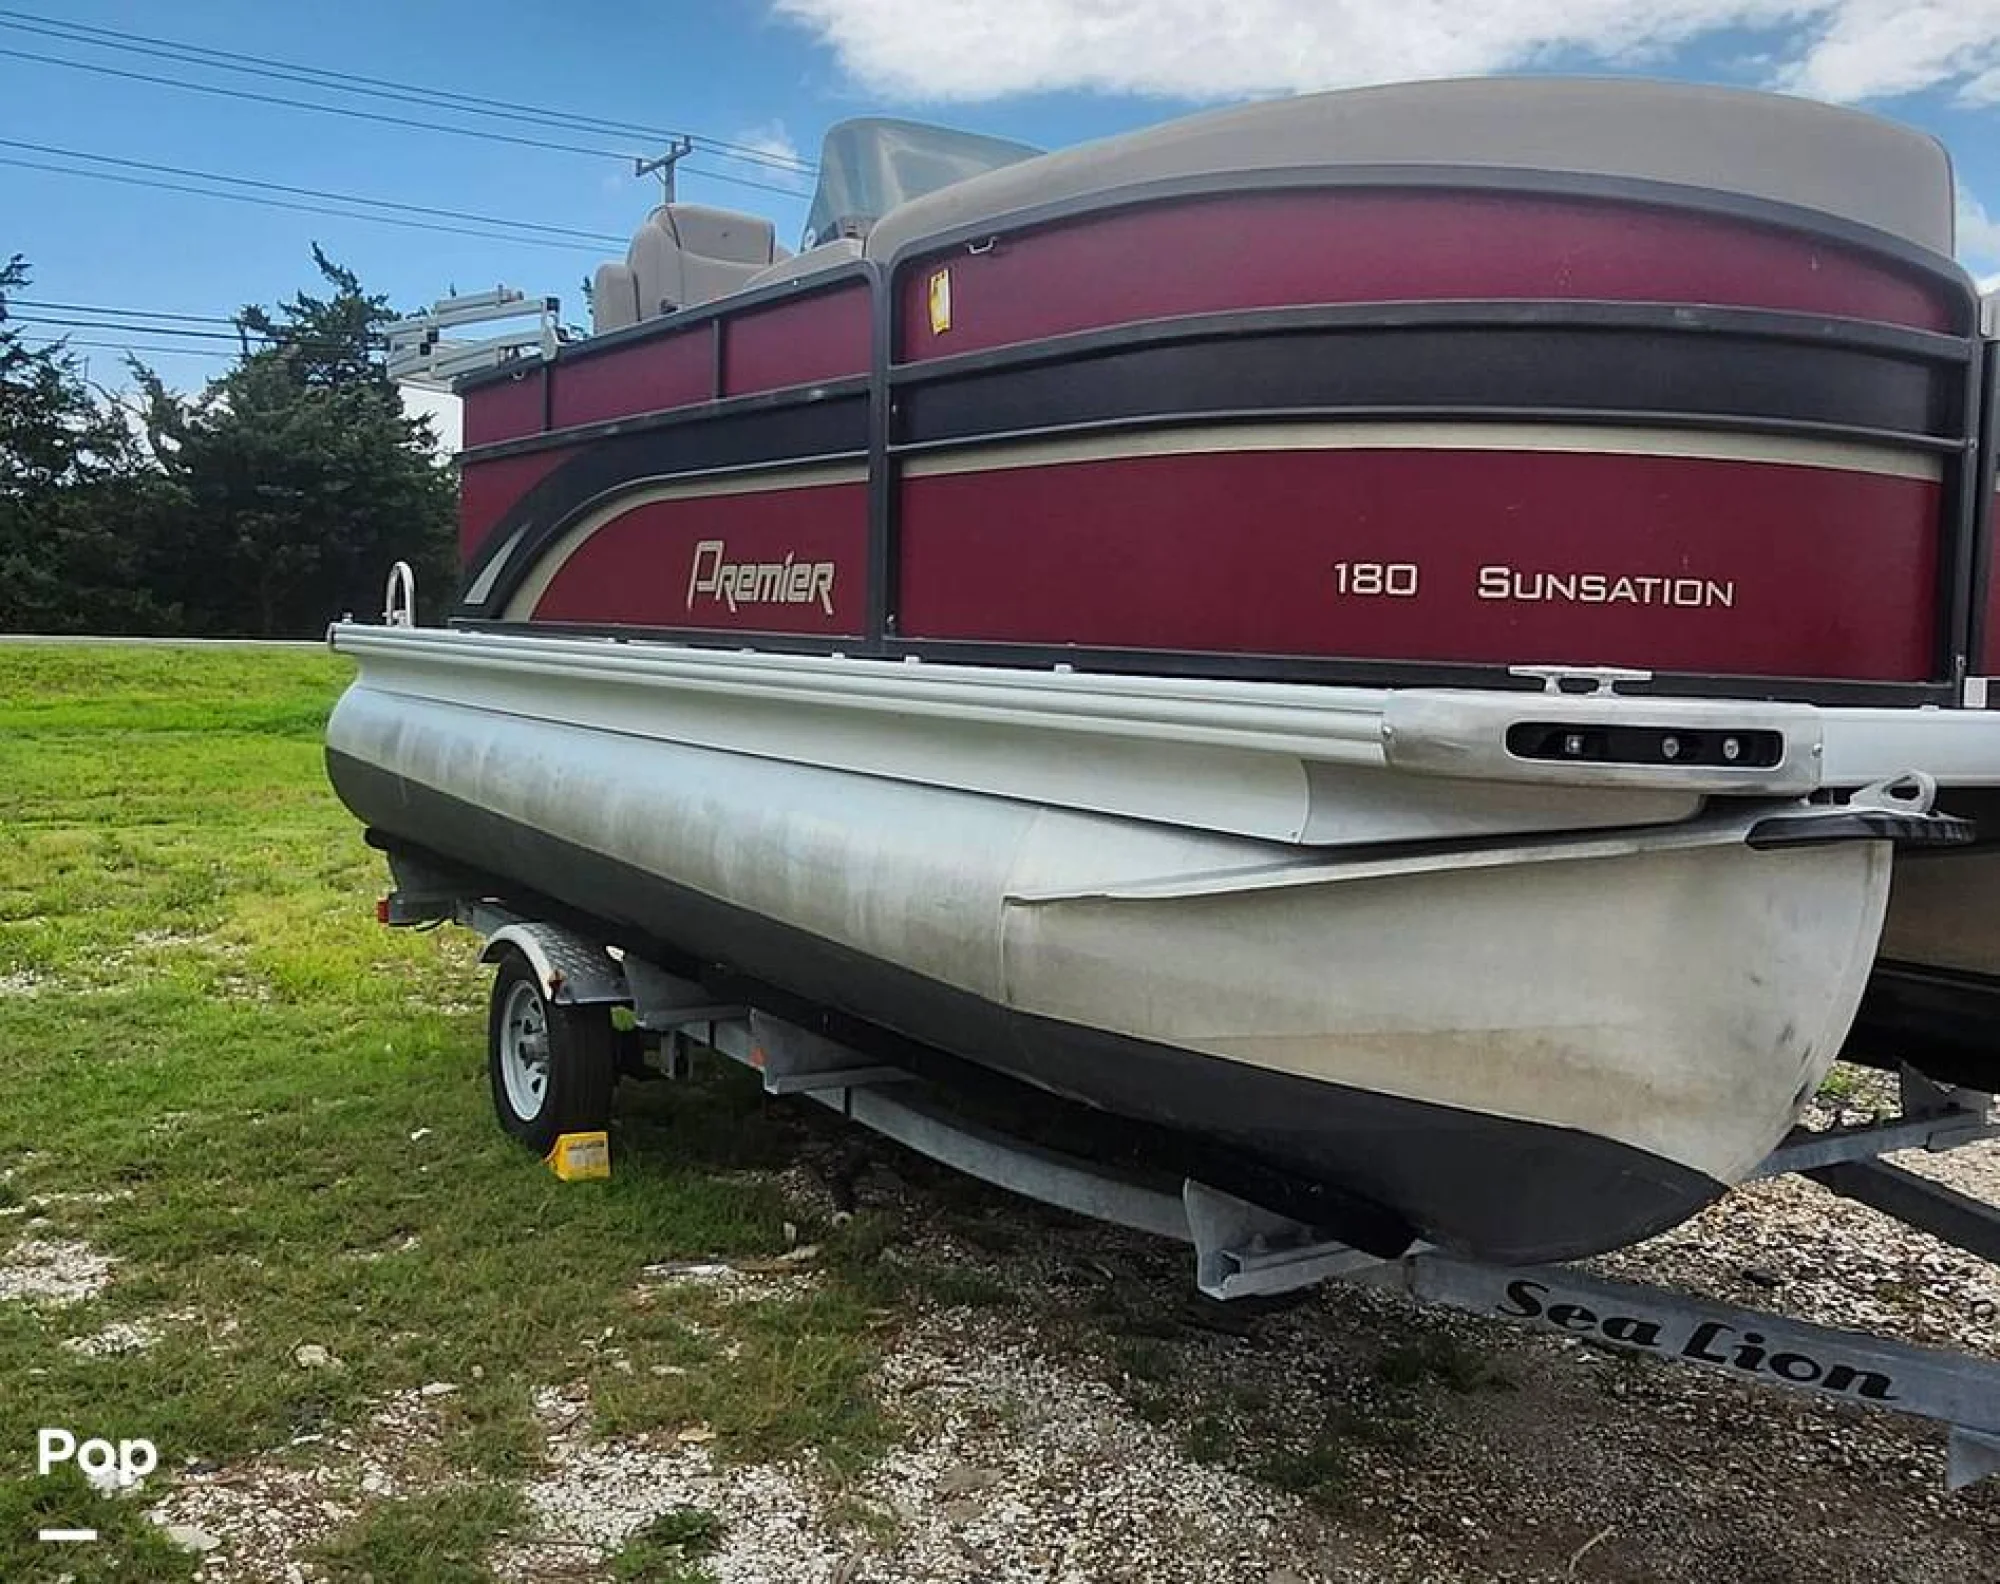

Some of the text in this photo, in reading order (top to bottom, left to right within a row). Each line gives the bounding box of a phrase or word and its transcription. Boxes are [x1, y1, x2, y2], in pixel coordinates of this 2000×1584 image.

[1333, 562, 1735, 607] 180 SUNSATION
[1498, 1279, 1900, 1401] Sea Lion
